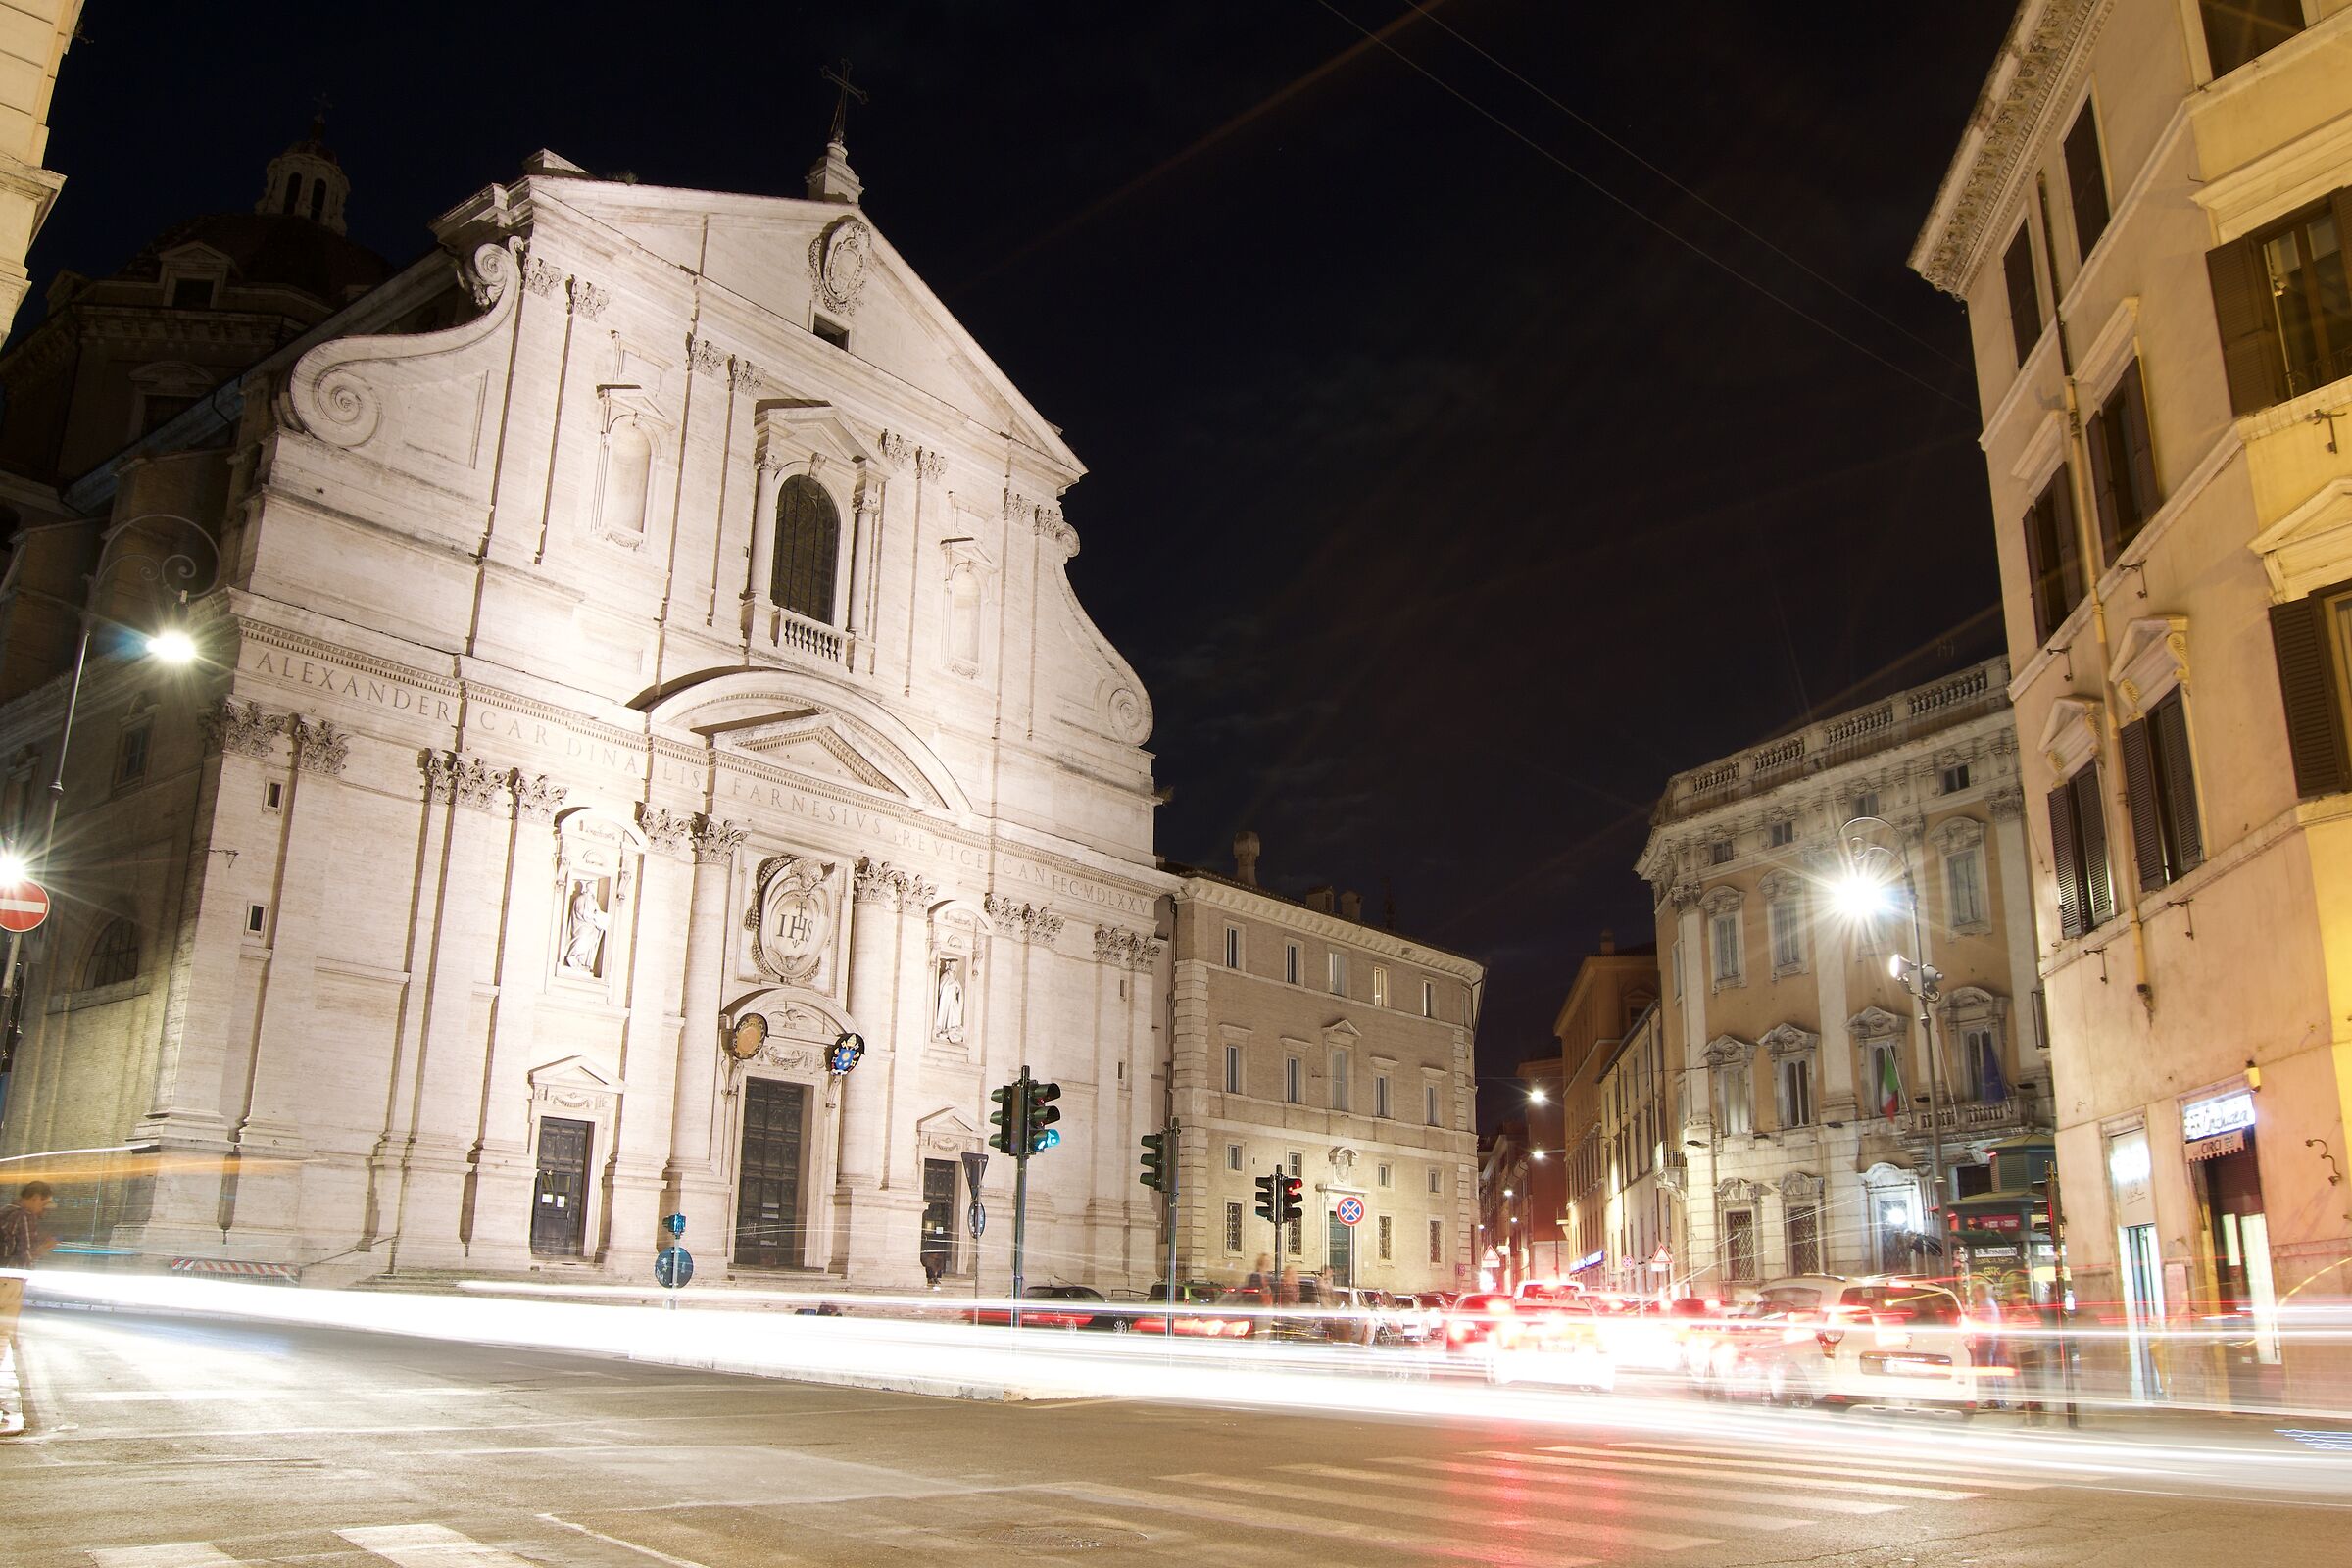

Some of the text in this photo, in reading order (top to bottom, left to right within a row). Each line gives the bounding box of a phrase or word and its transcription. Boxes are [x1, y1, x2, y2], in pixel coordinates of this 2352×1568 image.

[256, 651, 450, 722] ALEXANDER
[733, 777, 881, 834] FARNESIVS
[776, 912, 814, 943] IHS
